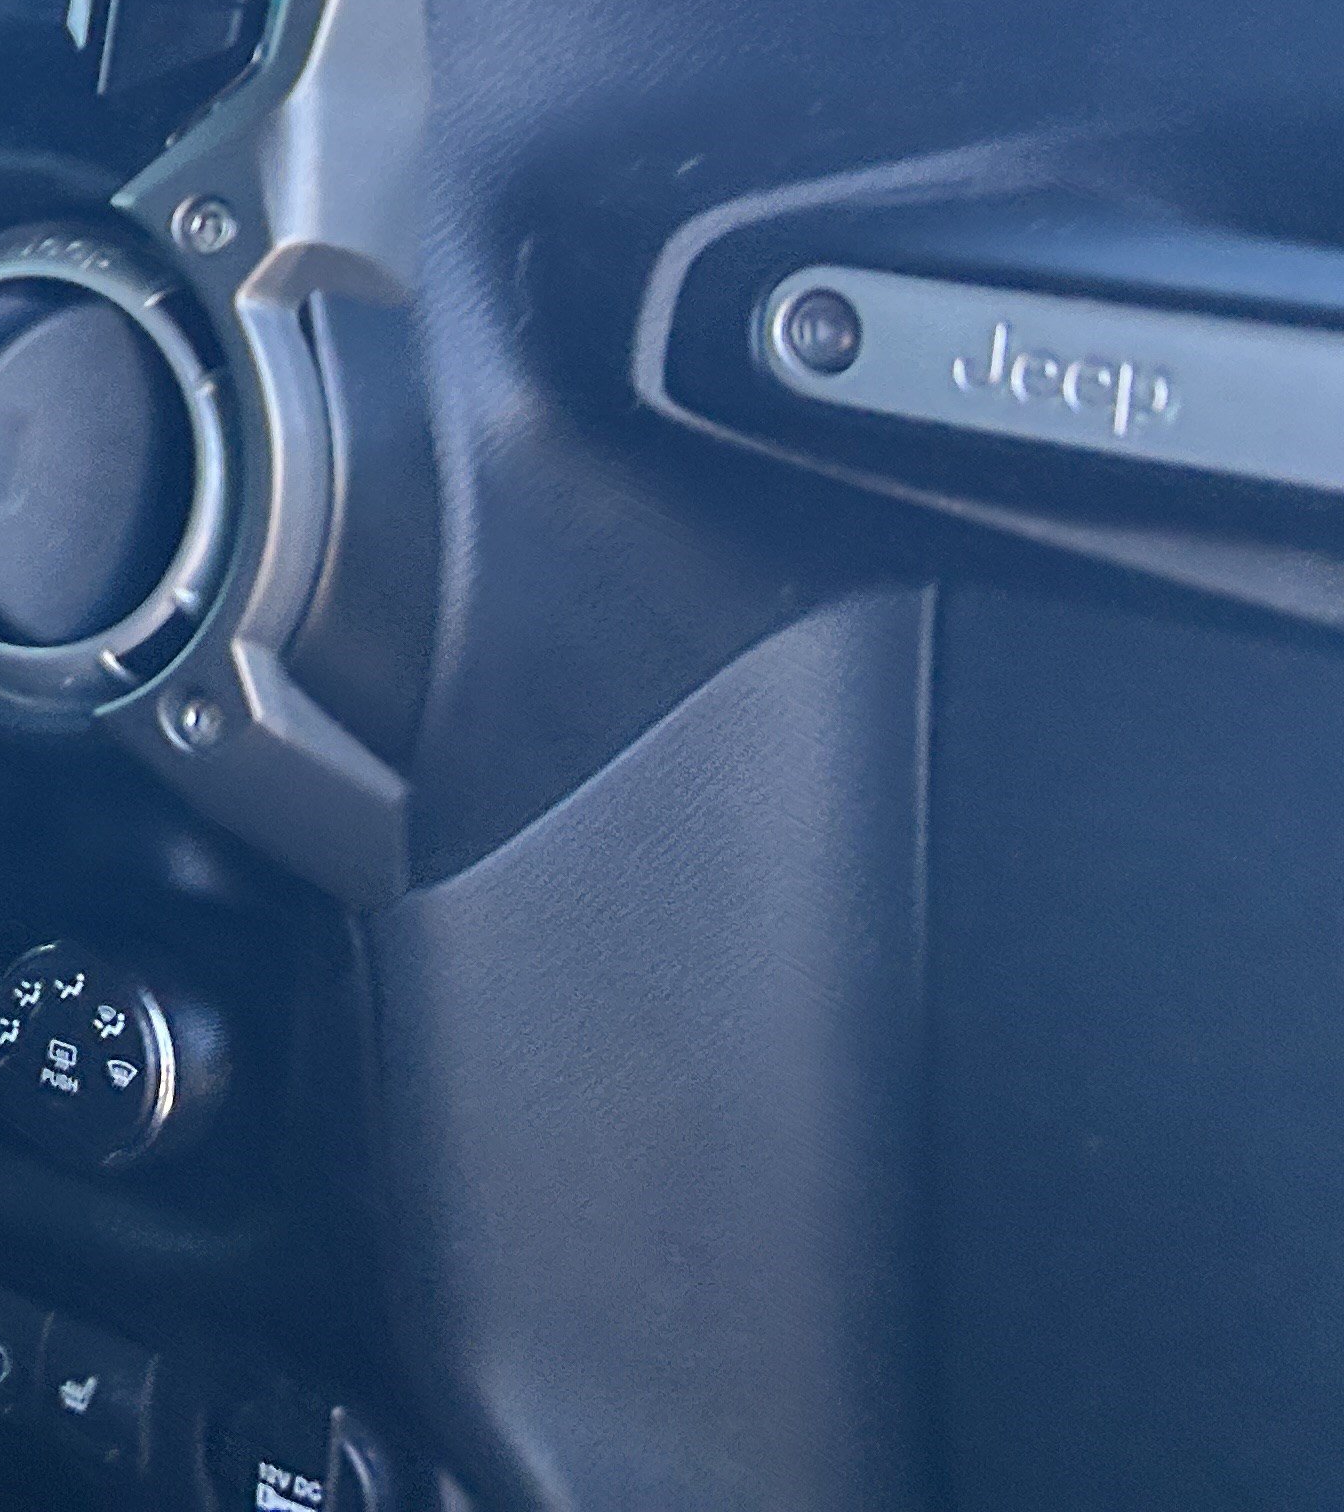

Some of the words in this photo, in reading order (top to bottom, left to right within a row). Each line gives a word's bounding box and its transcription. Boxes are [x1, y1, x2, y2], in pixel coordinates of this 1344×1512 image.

[952, 321, 1174, 438] Jeep
[41, 1068, 79, 1093] PUSH
[293, 1476, 322, 1503] DC
